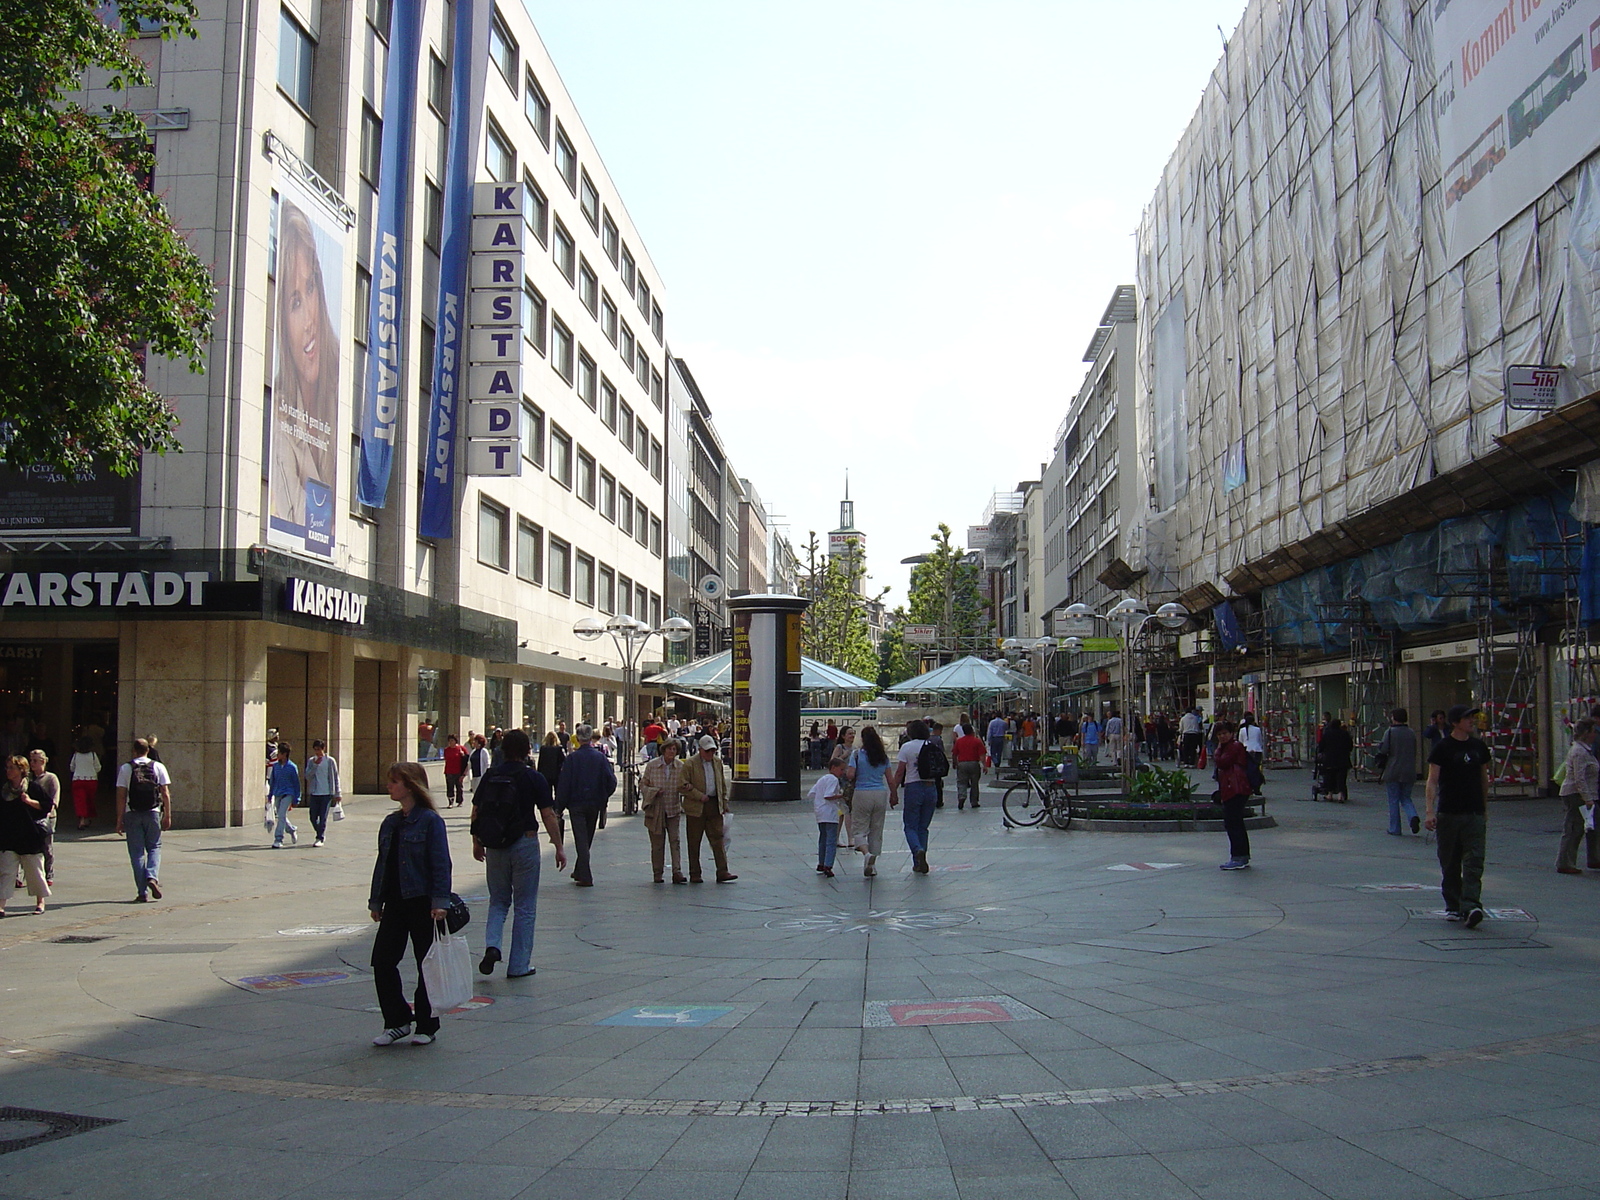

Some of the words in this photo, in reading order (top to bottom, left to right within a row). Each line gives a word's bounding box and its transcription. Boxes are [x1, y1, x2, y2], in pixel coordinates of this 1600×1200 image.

[373, 231, 398, 446] KARSTADT
[488, 186, 516, 470] KARSTADT
[433, 293, 459, 484] KARSTADT
[48, 473, 97, 483] ASKBAN
[308, 529, 330, 545] KARSTADT
[293, 577, 368, 625] KARSTADT
